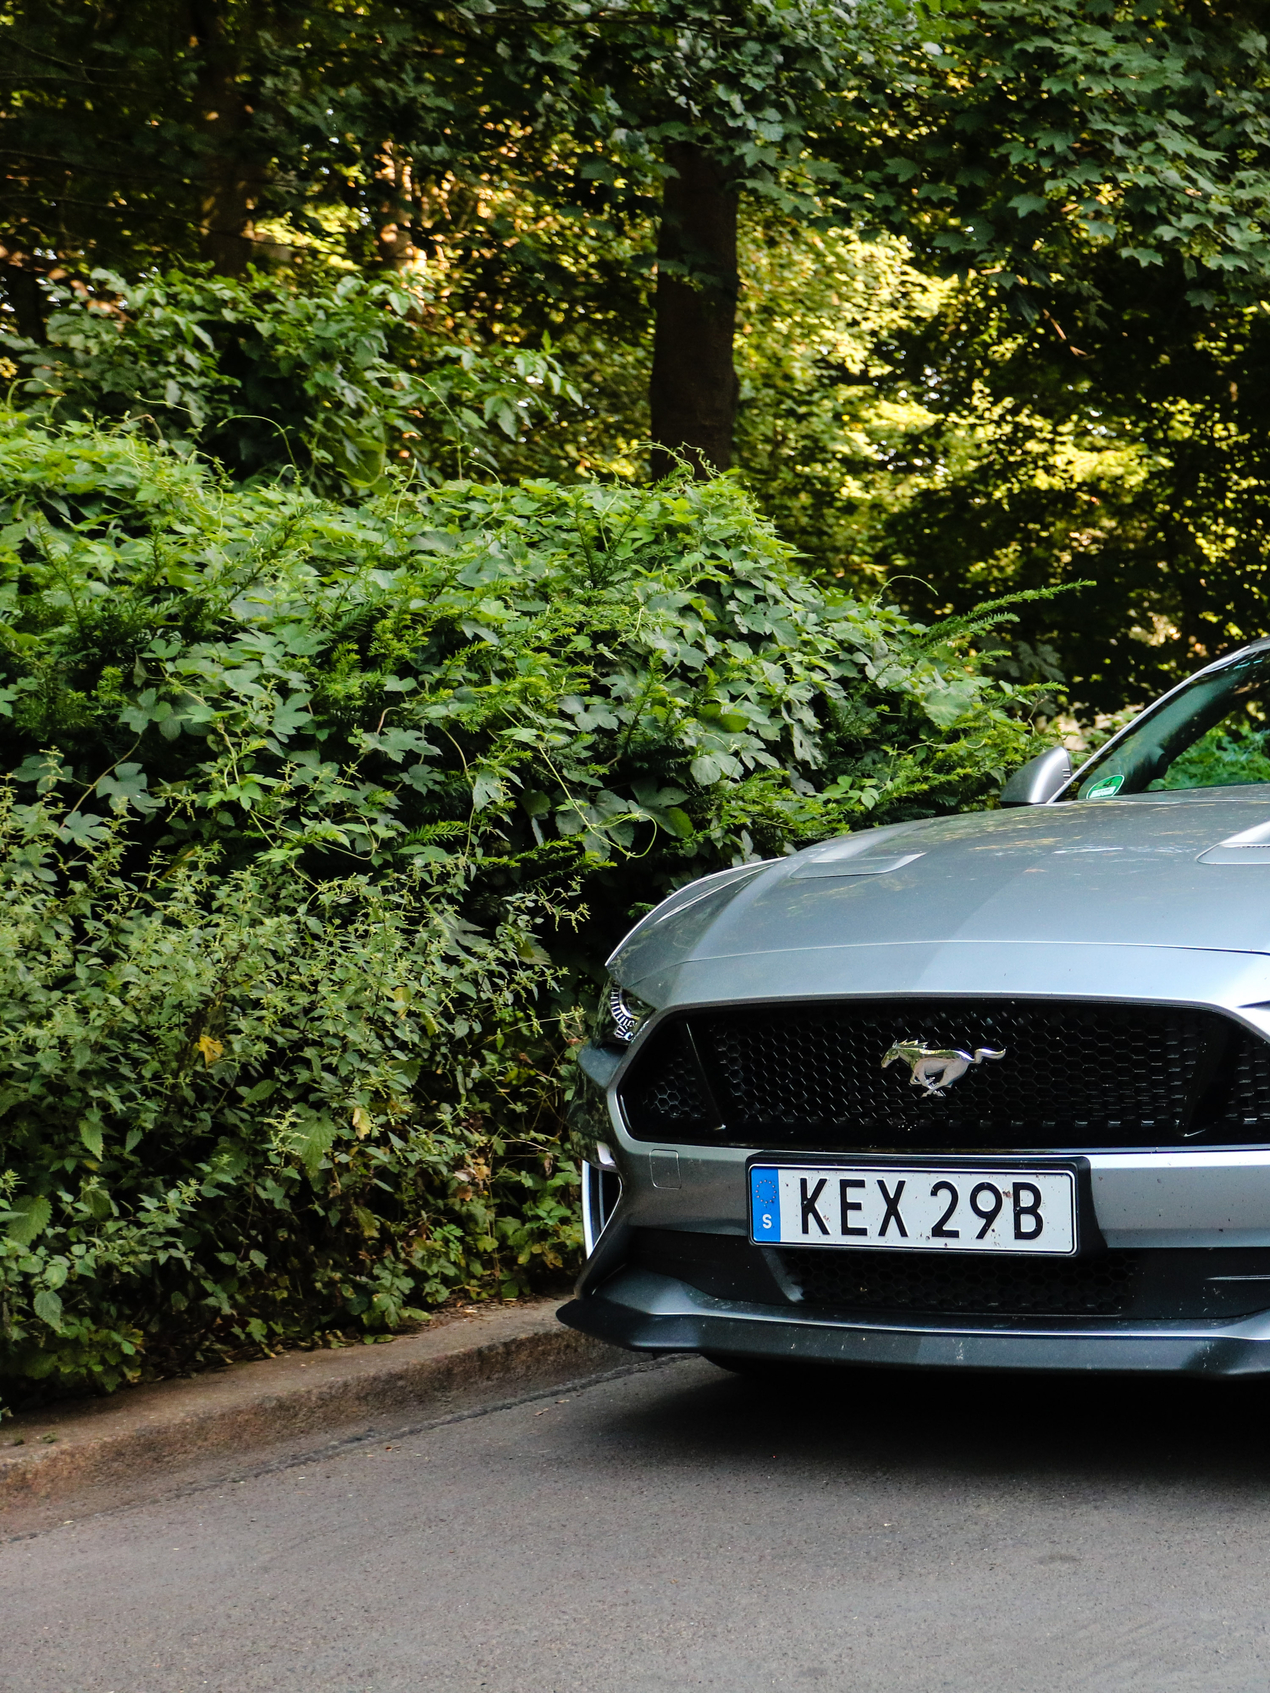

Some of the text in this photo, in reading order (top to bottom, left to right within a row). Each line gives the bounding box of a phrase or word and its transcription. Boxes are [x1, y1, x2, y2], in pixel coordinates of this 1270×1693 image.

[762, 1213, 772, 1230] S
[799, 1177, 1044, 1240] KEX 29B
